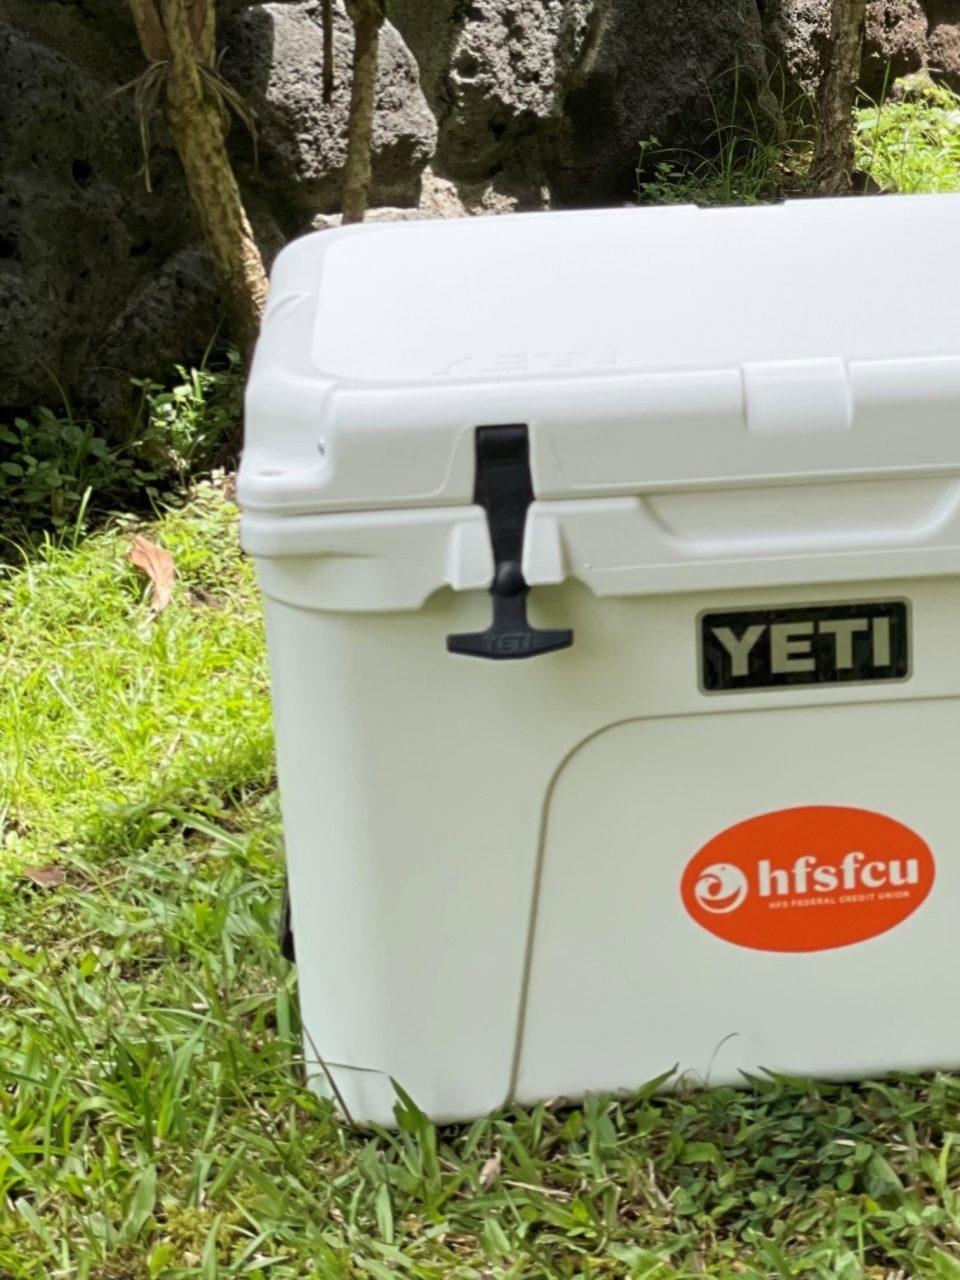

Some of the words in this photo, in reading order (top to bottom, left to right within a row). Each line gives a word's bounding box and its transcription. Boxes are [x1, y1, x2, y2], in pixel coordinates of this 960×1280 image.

[710, 616, 891, 677] YETI
[757, 851, 919, 897] hfsfcu
[768, 900, 789, 910] HFS
[790, 897, 837, 908] FEDERAL
[838, 892, 875, 904] CREDIT
[877, 889, 910, 901] UNION
